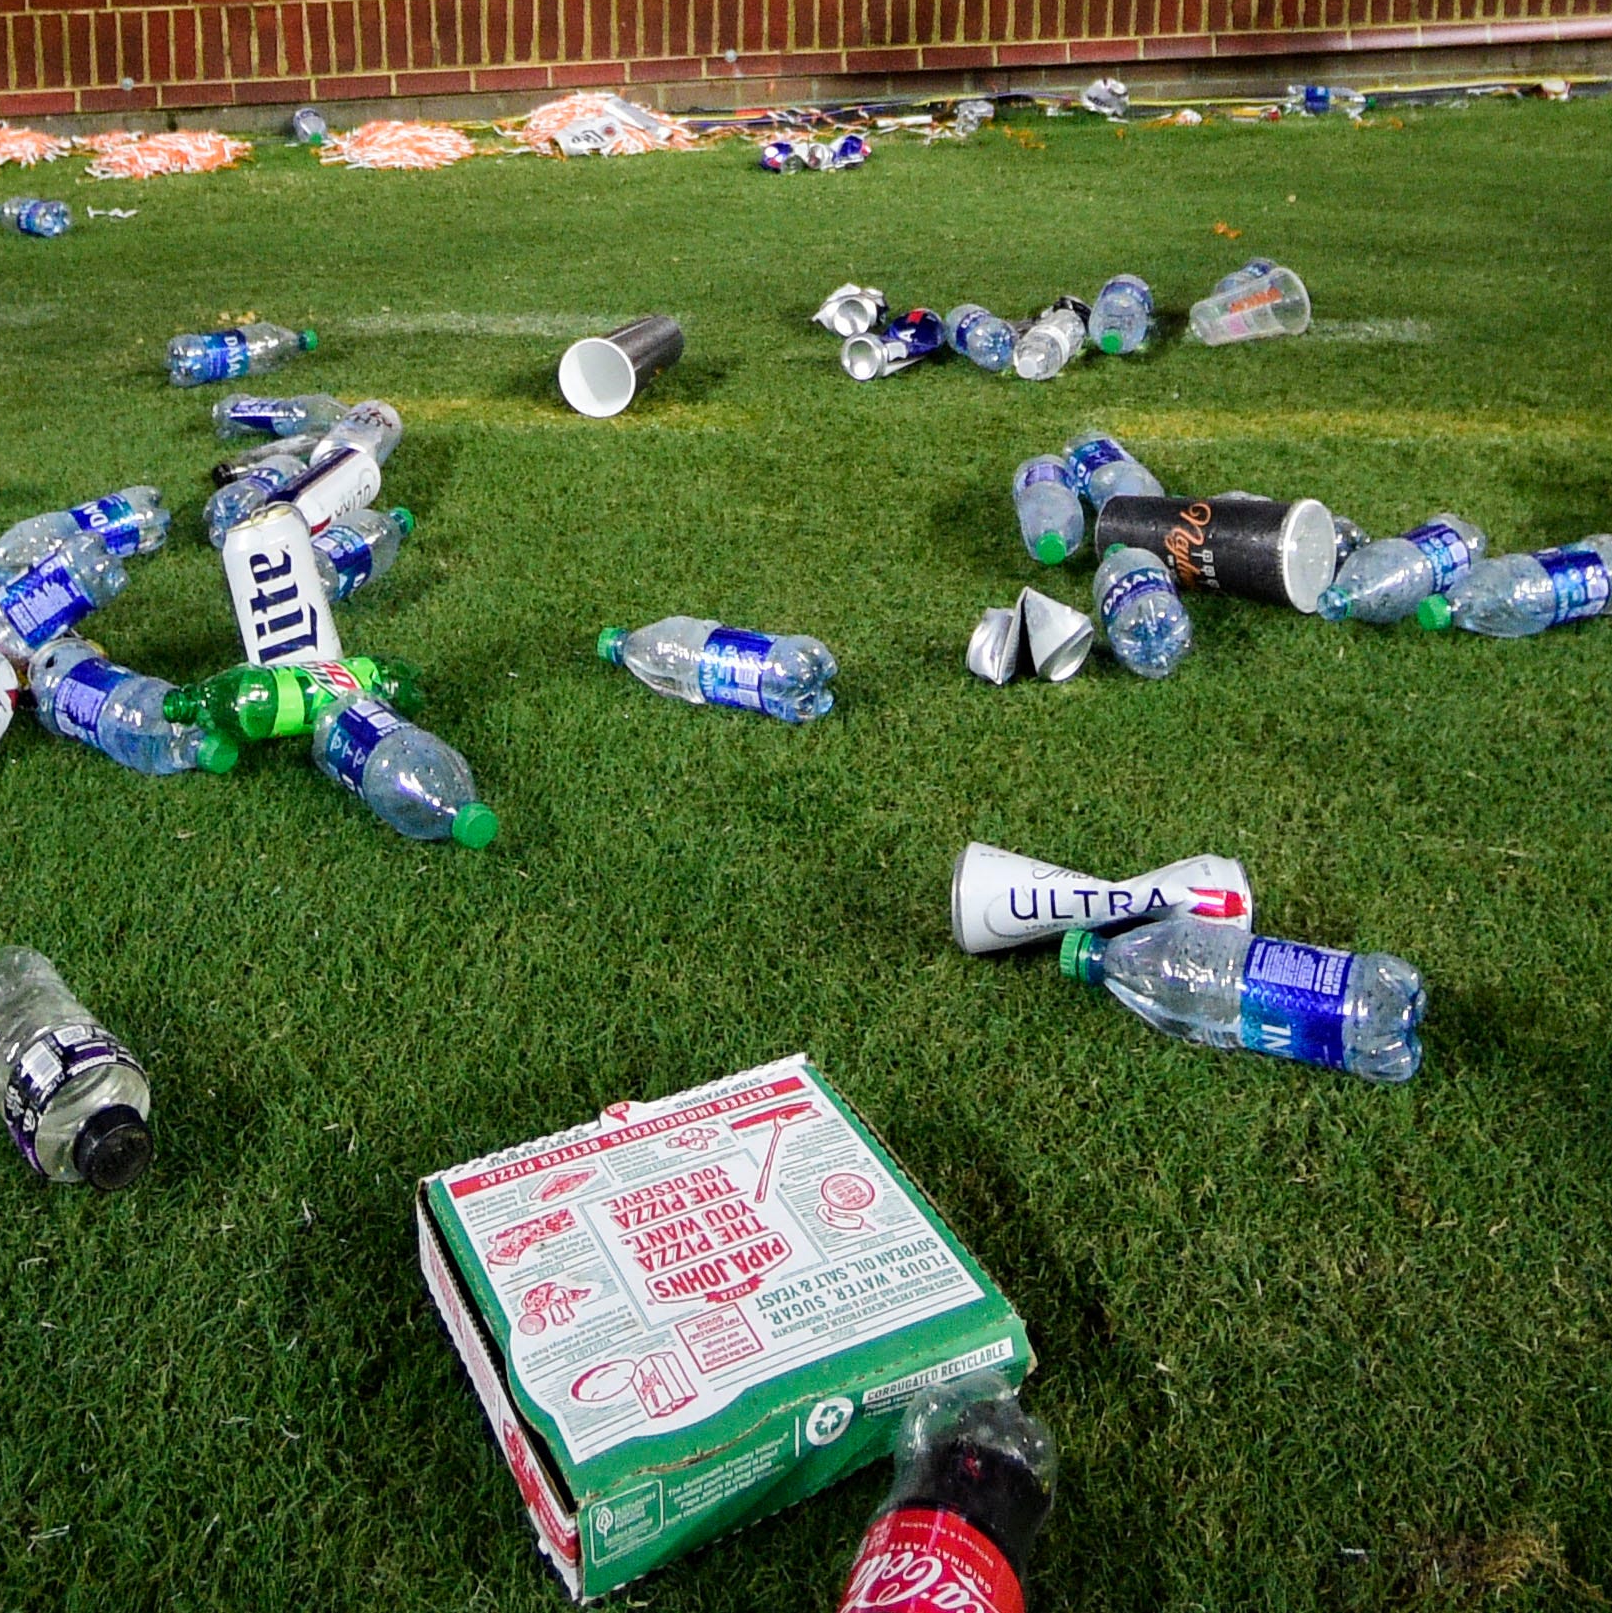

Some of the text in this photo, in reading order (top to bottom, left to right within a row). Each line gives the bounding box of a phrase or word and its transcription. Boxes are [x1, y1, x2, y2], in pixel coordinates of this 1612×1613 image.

[249, 548, 319, 665] Lite
[1010, 887, 1175, 921] ULTRA
[601, 1102, 716, 1149] INGREDIENTS.
[714, 1084, 776, 1112] BETTER
[536, 1138, 602, 1168] BETTER
[600, 1162, 728, 1216] YOU DESERVE.
[608, 1174, 740, 1233] THE PIZZA
[619, 1196, 755, 1257] YOU WANT.
[633, 1212, 769, 1275] THE PIZZA
[650, 1236, 791, 1307] PAPA JOHN'S
[718, 1282, 753, 1301] PIZZA
[750, 1234, 940, 1312] SOYBEAN OIL, SALT & YEAST
[759, 1247, 951, 1330] FLOUR, WATER, SUGAR,
[869, 1342, 1005, 1400] CORRUGATED RECYCLABLE
[934, 1545, 992, 1594] ORIGINAL
